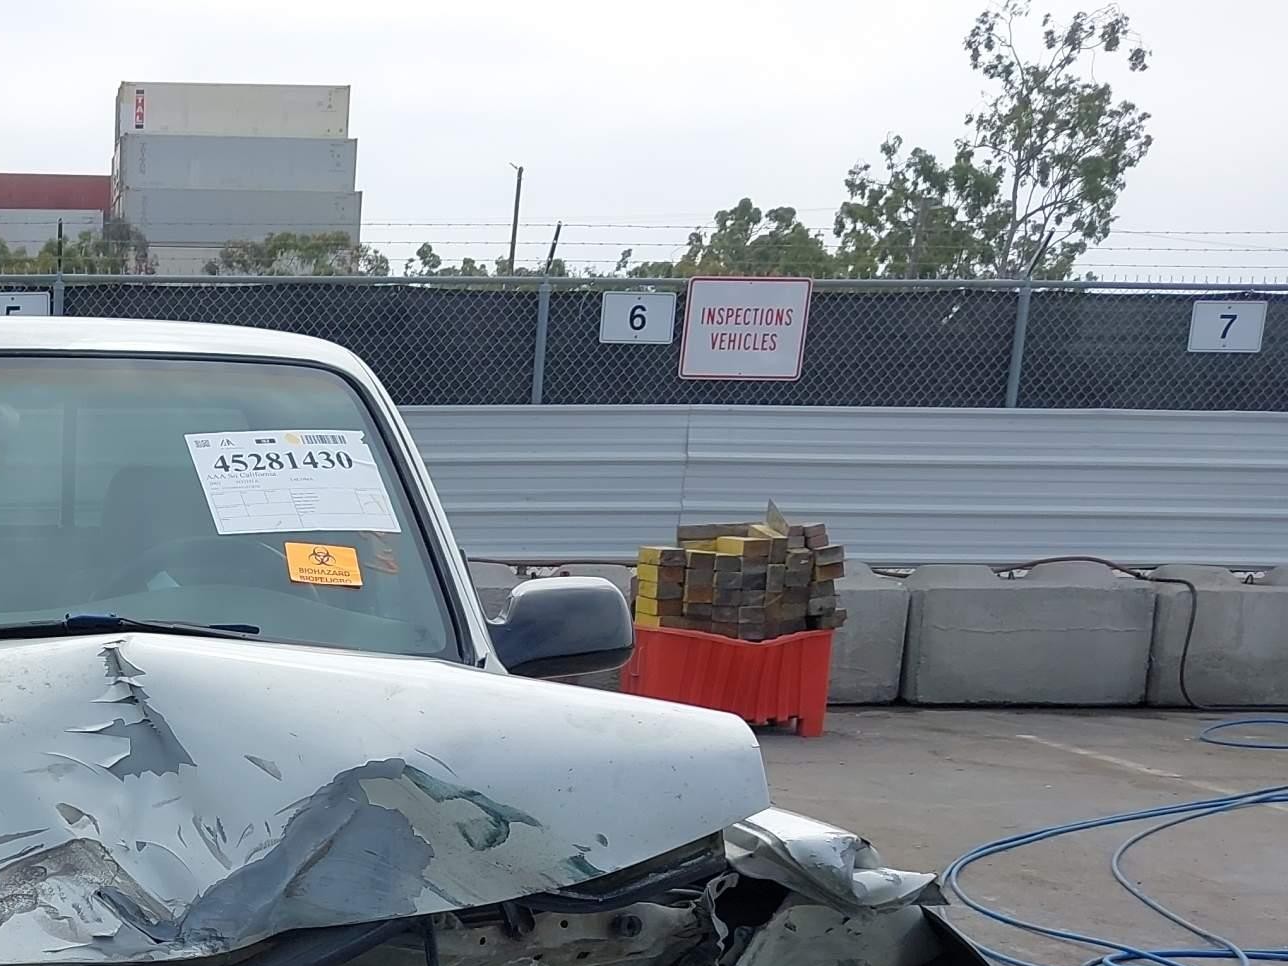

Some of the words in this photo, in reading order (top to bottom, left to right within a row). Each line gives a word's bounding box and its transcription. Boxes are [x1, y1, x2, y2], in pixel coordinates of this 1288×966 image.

[136, 96, 144, 122] TAL
[629, 305, 647, 331] 6
[700, 307, 794, 327] INSPECTIONS
[1220, 314, 1238, 339] 7
[711, 333, 778, 351] VEHICLES
[214, 451, 353, 473] 45281430
[298, 567, 351, 577] BIOHAZARD
[299, 575, 353, 584] BIOPELIGRO
